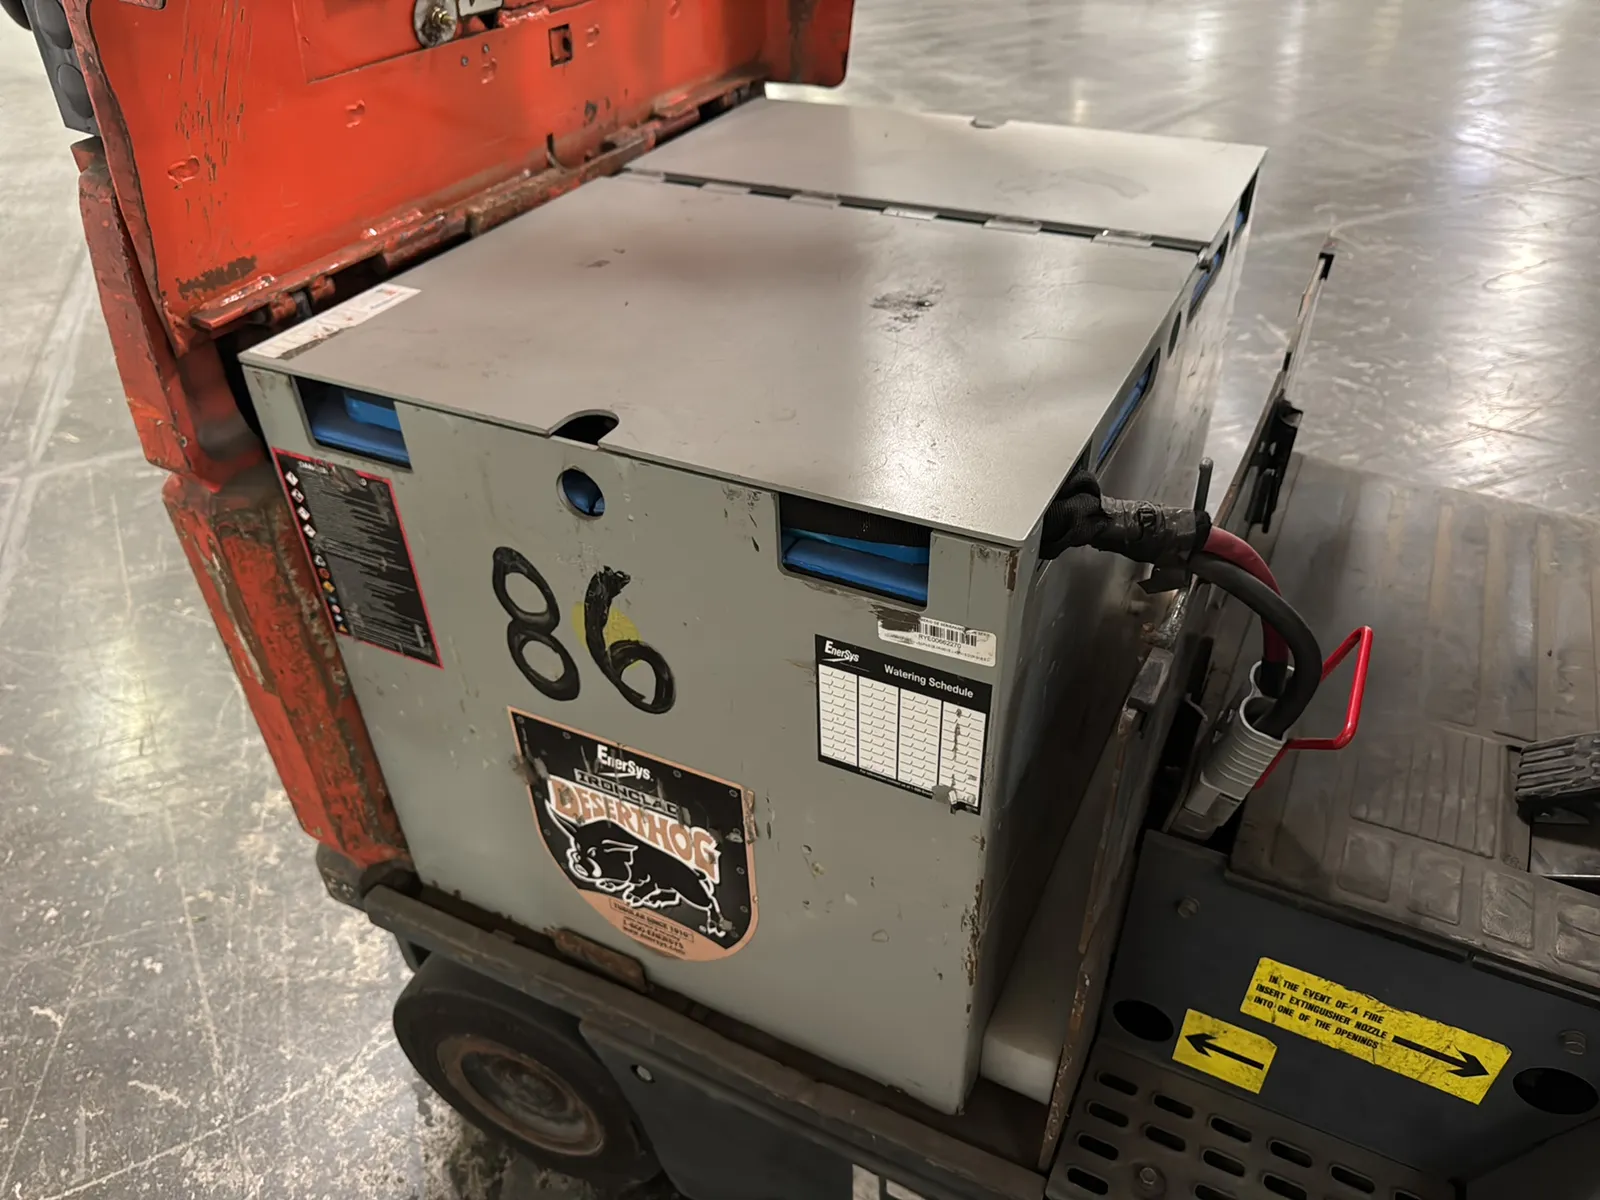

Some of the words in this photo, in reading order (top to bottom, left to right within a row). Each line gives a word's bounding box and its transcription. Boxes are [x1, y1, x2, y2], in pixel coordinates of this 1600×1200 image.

[492, 546, 676, 714] 86
[824, 640, 860, 663] EnerSys
[884, 664, 927, 686] Watering
[928, 677, 974, 698] Schedule
[548, 775, 721, 884] DESERTHOG
[1253, 995, 1274, 1009] INTO
[1277, 1004, 1295, 1017] ONE
[1298, 1012, 1310, 1022] OF
[1314, 1018, 1332, 1031] THE
[1335, 1027, 1379, 1049] OPENINGS
[1255, 983, 1286, 1000] INSERT
[1289, 994, 1351, 1025] EXTINGUISHER
[1354, 1020, 1388, 1039] NOZZLE
[1268, 974, 1278, 985] IN
[1283, 979, 1299, 993] THE
[1302, 989, 1332, 1004] EVENT
[1335, 1000, 1348, 1010] OF
[1351, 1006, 1358, 1015] A
[1362, 1010, 1384, 1024] FIRE
